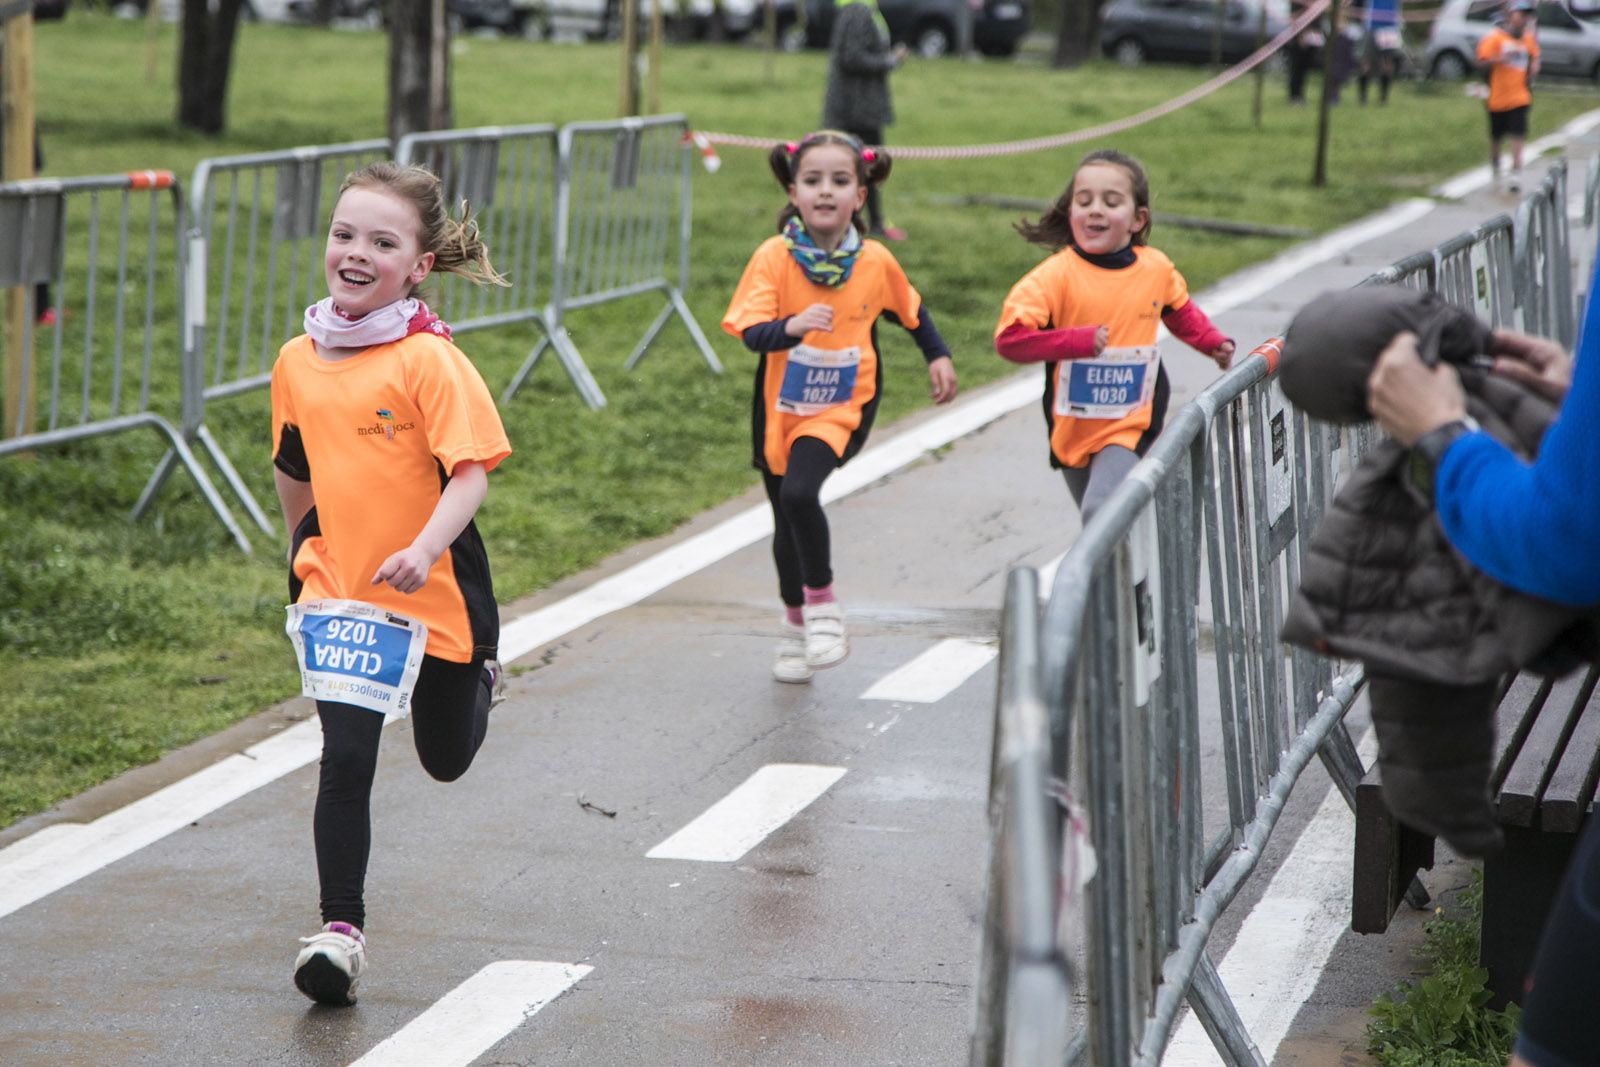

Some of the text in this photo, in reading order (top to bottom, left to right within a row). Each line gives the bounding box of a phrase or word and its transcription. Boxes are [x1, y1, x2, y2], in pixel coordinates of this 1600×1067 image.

[805, 369, 840, 385] LAIA
[1086, 366, 1134, 384] ELENA
[803, 386, 837, 403] 1027
[1091, 387, 1128, 404] 1030
[326, 618, 378, 646] 1026
[314, 643, 382, 675] CLARA
[398, 692, 408, 710] 1026
